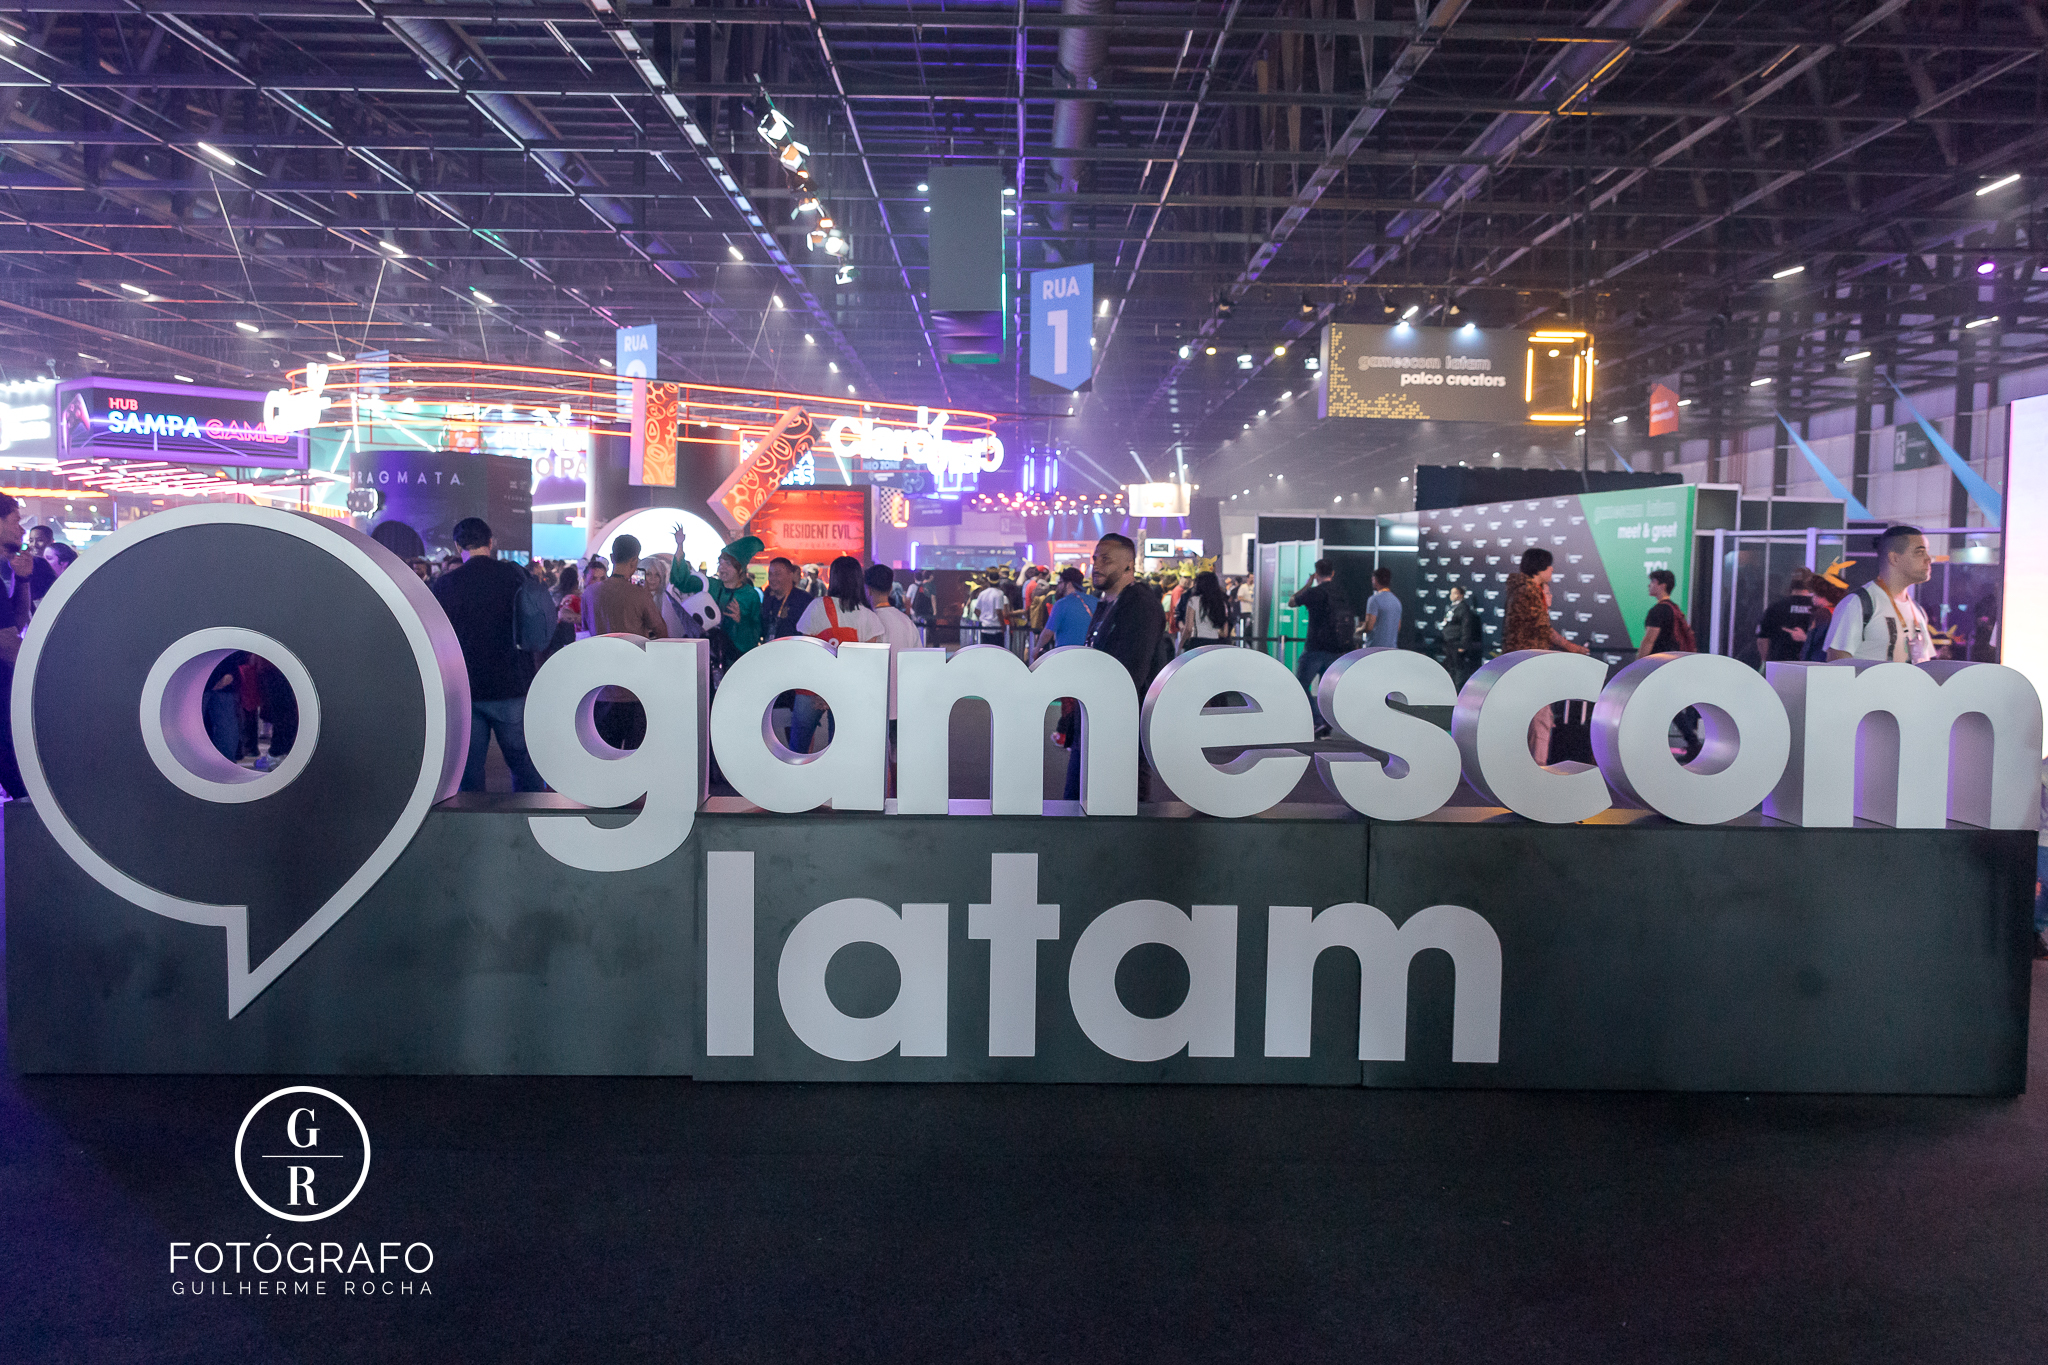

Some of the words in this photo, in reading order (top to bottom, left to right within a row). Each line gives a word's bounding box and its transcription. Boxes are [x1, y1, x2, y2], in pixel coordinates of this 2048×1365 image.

[1043, 276, 1081, 300] RUA
[624, 334, 649, 352] RUA
[1047, 309, 1068, 375] 1
[1400, 371, 1444, 387] palco
[1446, 373, 1507, 387] creators
[108, 397, 139, 411] HUB
[107, 411, 202, 439] SAMPA
[351, 470, 462, 486] PRAGMATA
[783, 523, 829, 539] RESIDENT
[832, 524, 850, 539] EVIL
[1617, 522, 1642, 539] meet
[1651, 521, 1678, 543] greet
[523, 634, 2044, 873] gamescom
[706, 850, 1503, 1064] latam
